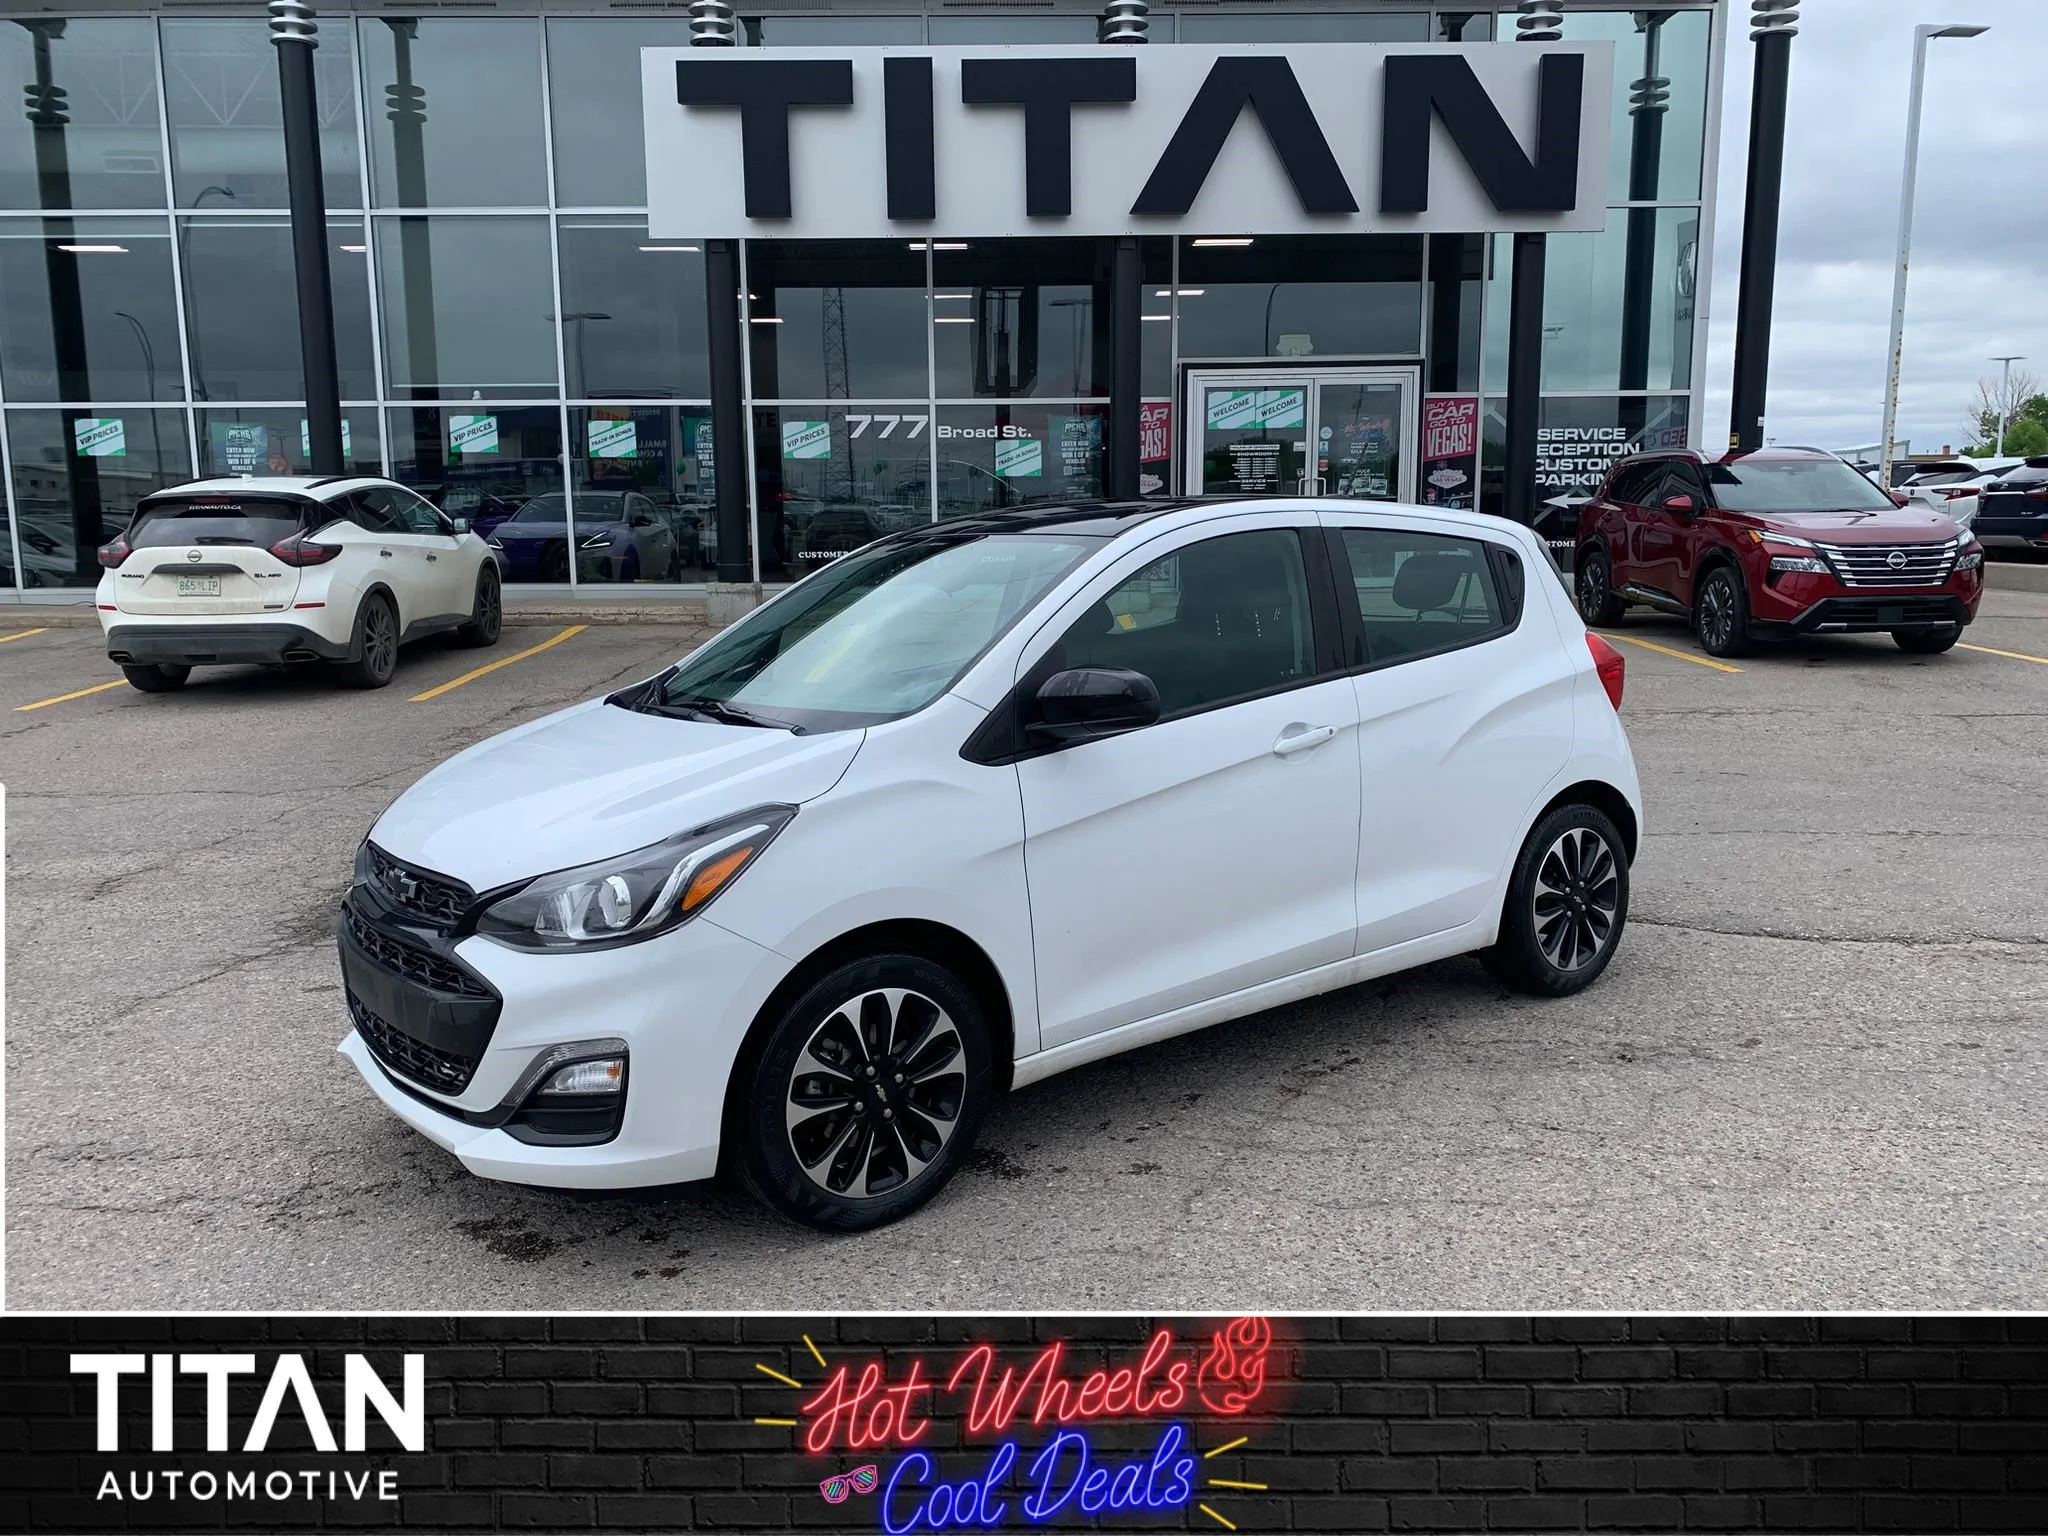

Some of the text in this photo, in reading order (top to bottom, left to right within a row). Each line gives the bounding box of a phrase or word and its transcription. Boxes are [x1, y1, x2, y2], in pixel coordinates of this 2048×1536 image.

[675, 53, 1584, 220] TITAN
[1213, 398, 1250, 417] WELCOME
[1261, 396, 1298, 417] WELCOME
[1428, 404, 1474, 421] CAR
[454, 422, 492, 441] VIP PRICES
[845, 415, 1032, 438] 777 Broad St.
[1144, 421, 1160, 429] TO
[1430, 420, 1447, 428] GO
[79, 424, 118, 446] VIP PRICES
[786, 428, 826, 448] VIP PRICES
[1427, 422, 1472, 457] VEGAS!
[1537, 428, 1626, 440] SERVICE
[179, 580, 218, 591] 865 LIP
